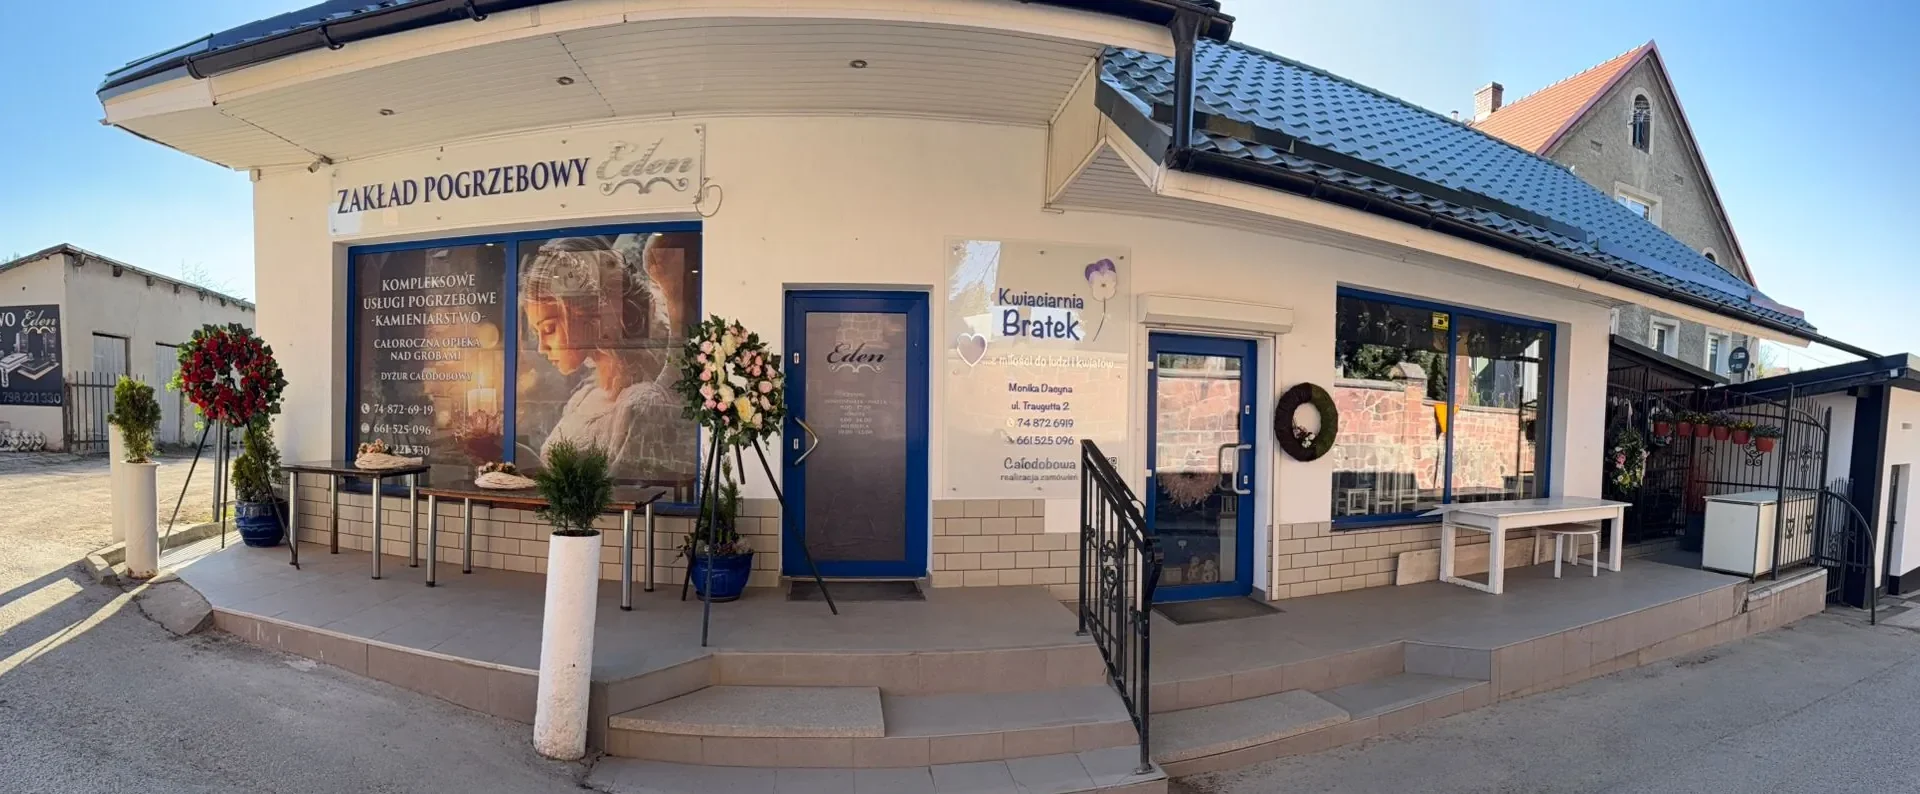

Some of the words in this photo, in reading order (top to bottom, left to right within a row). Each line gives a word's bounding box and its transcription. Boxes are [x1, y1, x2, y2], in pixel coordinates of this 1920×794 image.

[336, 180, 418, 214] ZAKŁAD
[424, 157, 590, 203] POGRZEBOWY
[596, 138, 694, 181] Eden
[382, 274, 476, 291] KOMPLEKSOWE
[363, 298, 405, 310] USŁUGI
[408, 292, 497, 308] POGRZEBOWE
[998, 287, 1084, 310] Kwiaciarnia
[0, 312, 16, 327] O
[1002, 309, 1080, 341] Bratek
[374, 338, 440, 349] CAŁOROCZNA
[442, 338, 481, 347] OPIEKA
[390, 351, 411, 361] NAD
[413, 351, 461, 361] GROBAMI
[827, 342, 885, 364] Eden
[1034, 355, 1046, 367] do
[1008, 382, 1040, 393] Monika
[22, 392, 39, 403] 221
[374, 403, 434, 416] 74-872-69-19
[1011, 400, 1020, 410] ul.
[1022, 401, 1061, 413] Traugutta
[1062, 401, 1070, 411] 2
[1017, 417, 1031, 428] 74
[1033, 417, 1051, 428] 872
[1053, 418, 1074, 428] 6919
[373, 424, 431, 436] 661-525-096
[1016, 435, 1033, 445] 661
[1034, 435, 1053, 445] 525
[1055, 435, 1075, 446] 096
[1003, 456, 1076, 470] Całodobowa
